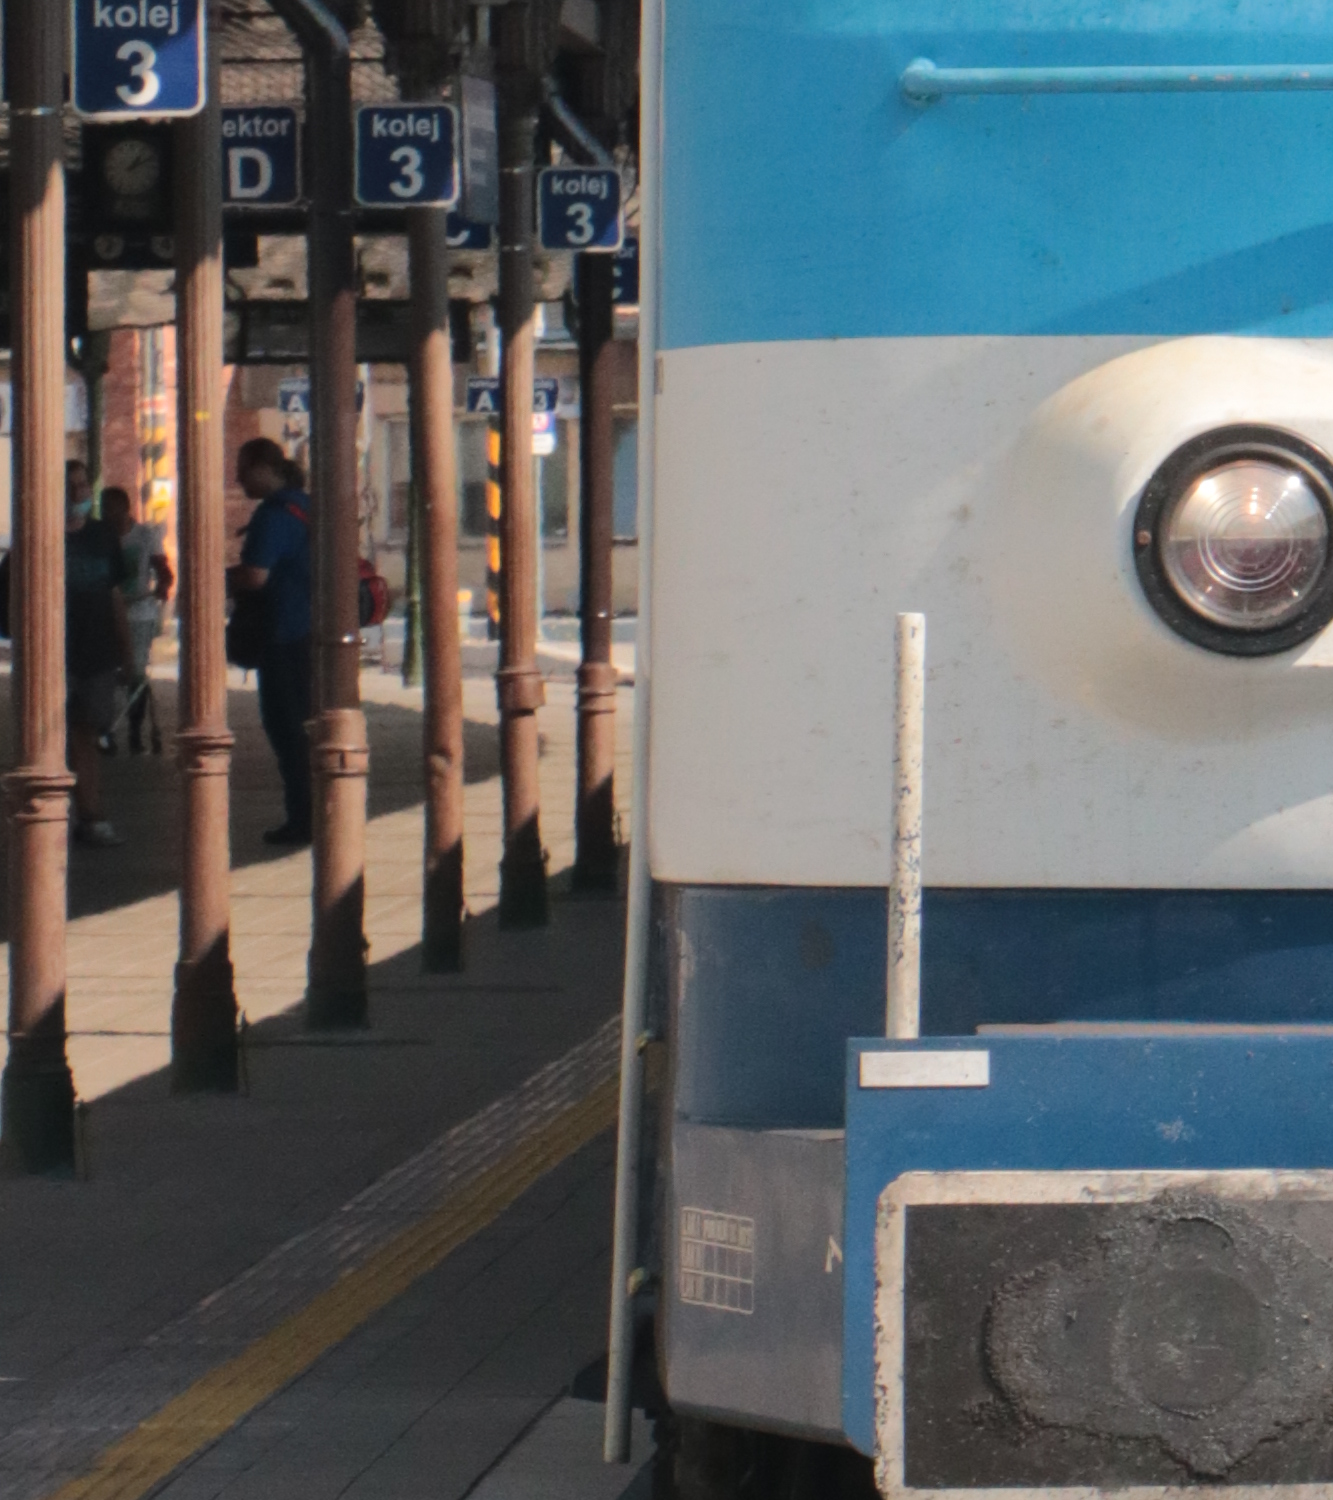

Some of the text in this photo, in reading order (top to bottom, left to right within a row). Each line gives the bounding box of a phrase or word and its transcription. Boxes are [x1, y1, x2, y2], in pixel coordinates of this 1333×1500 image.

[115, 39, 160, 106] 3
[222, 114, 290, 138] ektor
[372, 114, 440, 142] kolej
[228, 147, 273, 199] D
[389, 145, 424, 198] 3
[551, 175, 609, 199] kolej
[566, 202, 595, 245] 3
[475, 390, 494, 412] A
